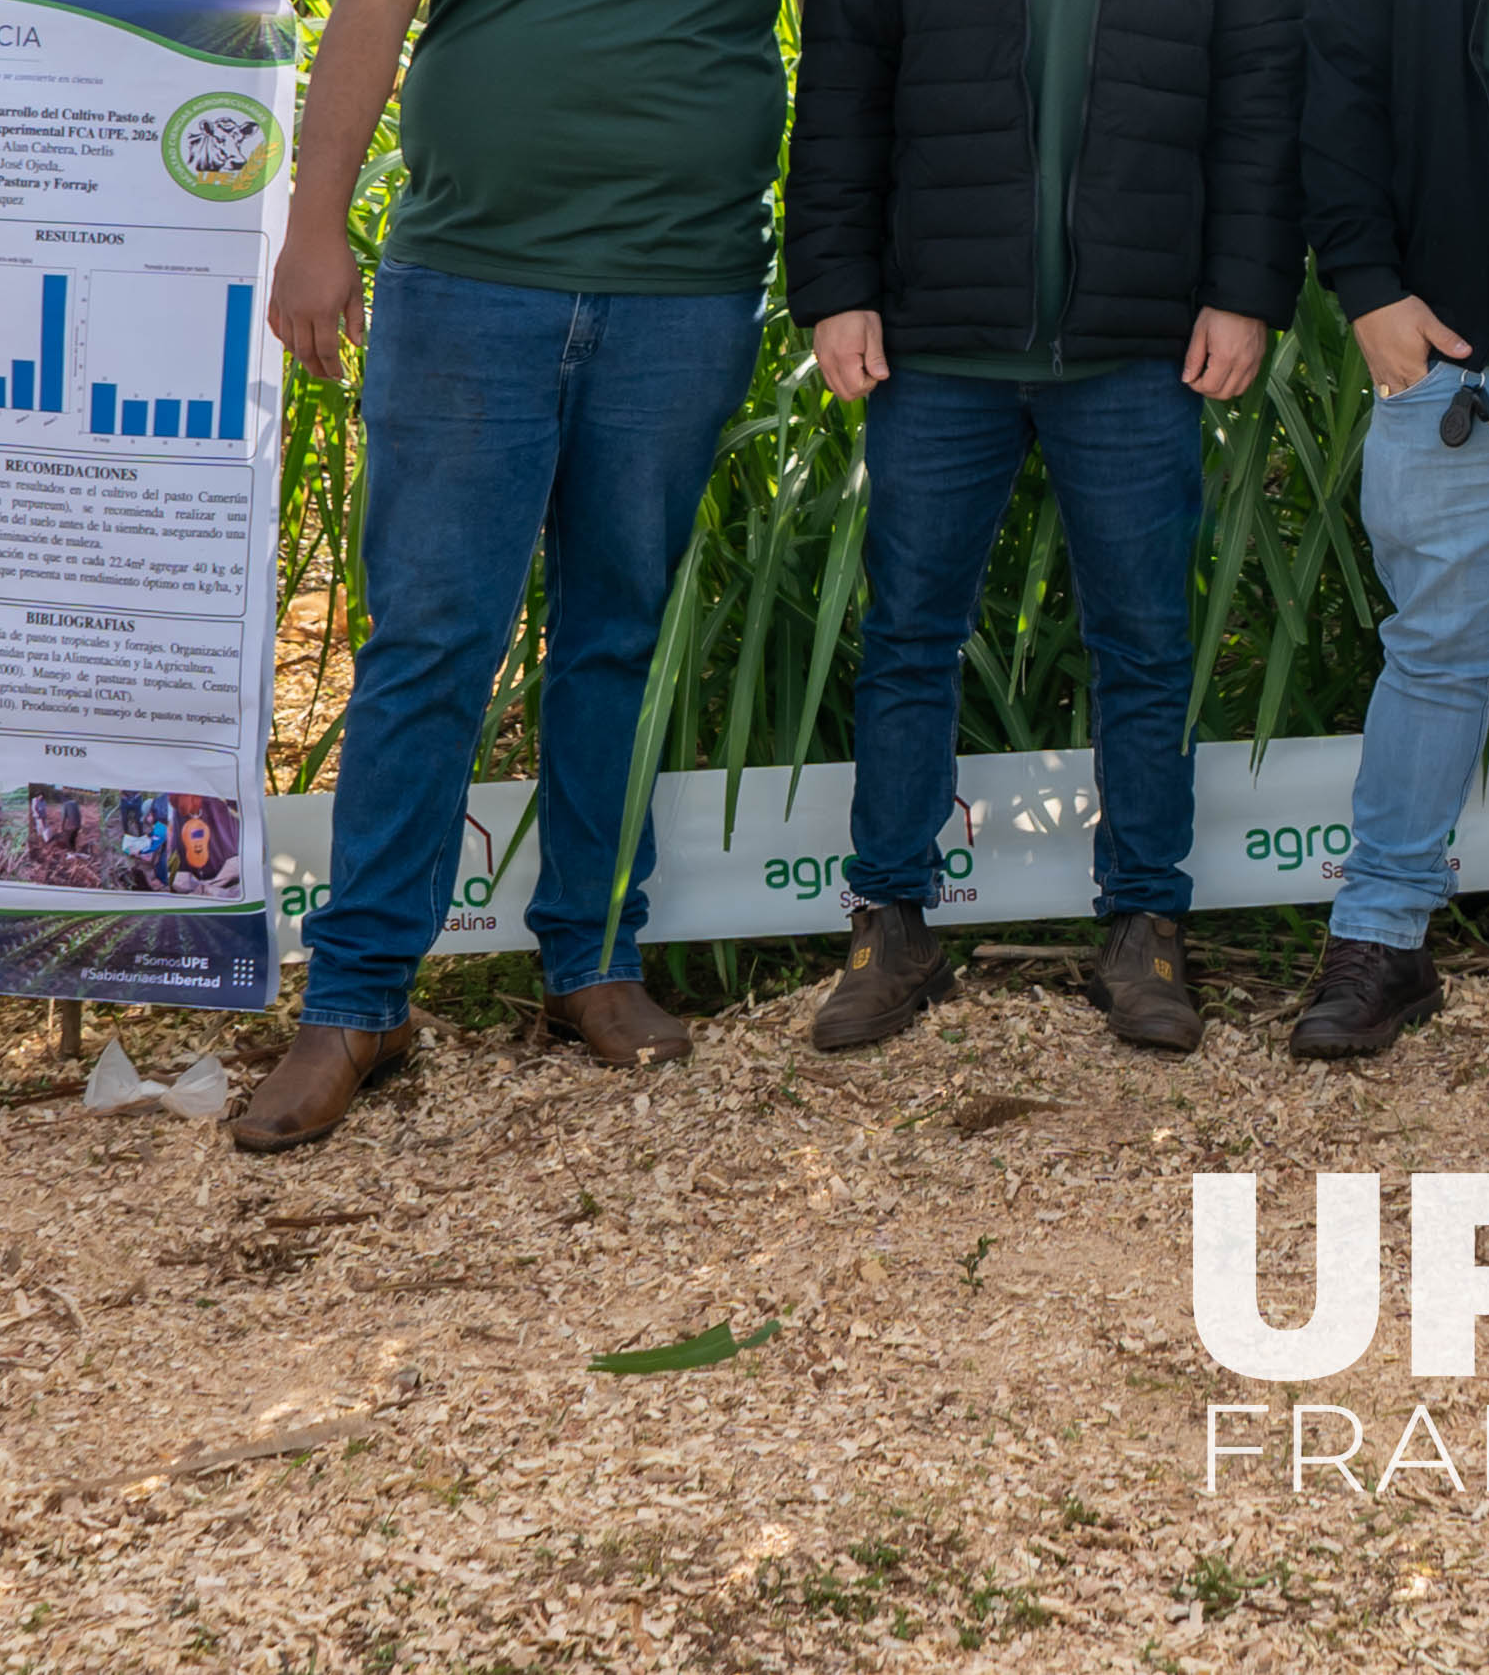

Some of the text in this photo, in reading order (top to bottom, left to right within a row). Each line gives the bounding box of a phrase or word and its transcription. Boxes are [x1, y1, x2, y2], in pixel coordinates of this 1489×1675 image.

[41, 107, 58, 119] del
[61, 108, 104, 121] Cultivo
[107, 110, 139, 123] Pasto
[141, 112, 155, 123] de
[68, 126, 95, 138] FCA
[98, 127, 128, 140] UPE,
[43, 180, 51, 191] y
[53, 177, 97, 193] Forraje
[35, 229, 124, 244] RESULTADOS
[5, 459, 137, 481] RECOMEDACIONES
[26, 611, 134, 632] BIBLIOGRAFIAS
[45, 744, 86, 757] FOTOS
[1245, 824, 1351, 871] agro
[135, 954, 209, 970] #SomosUPE
